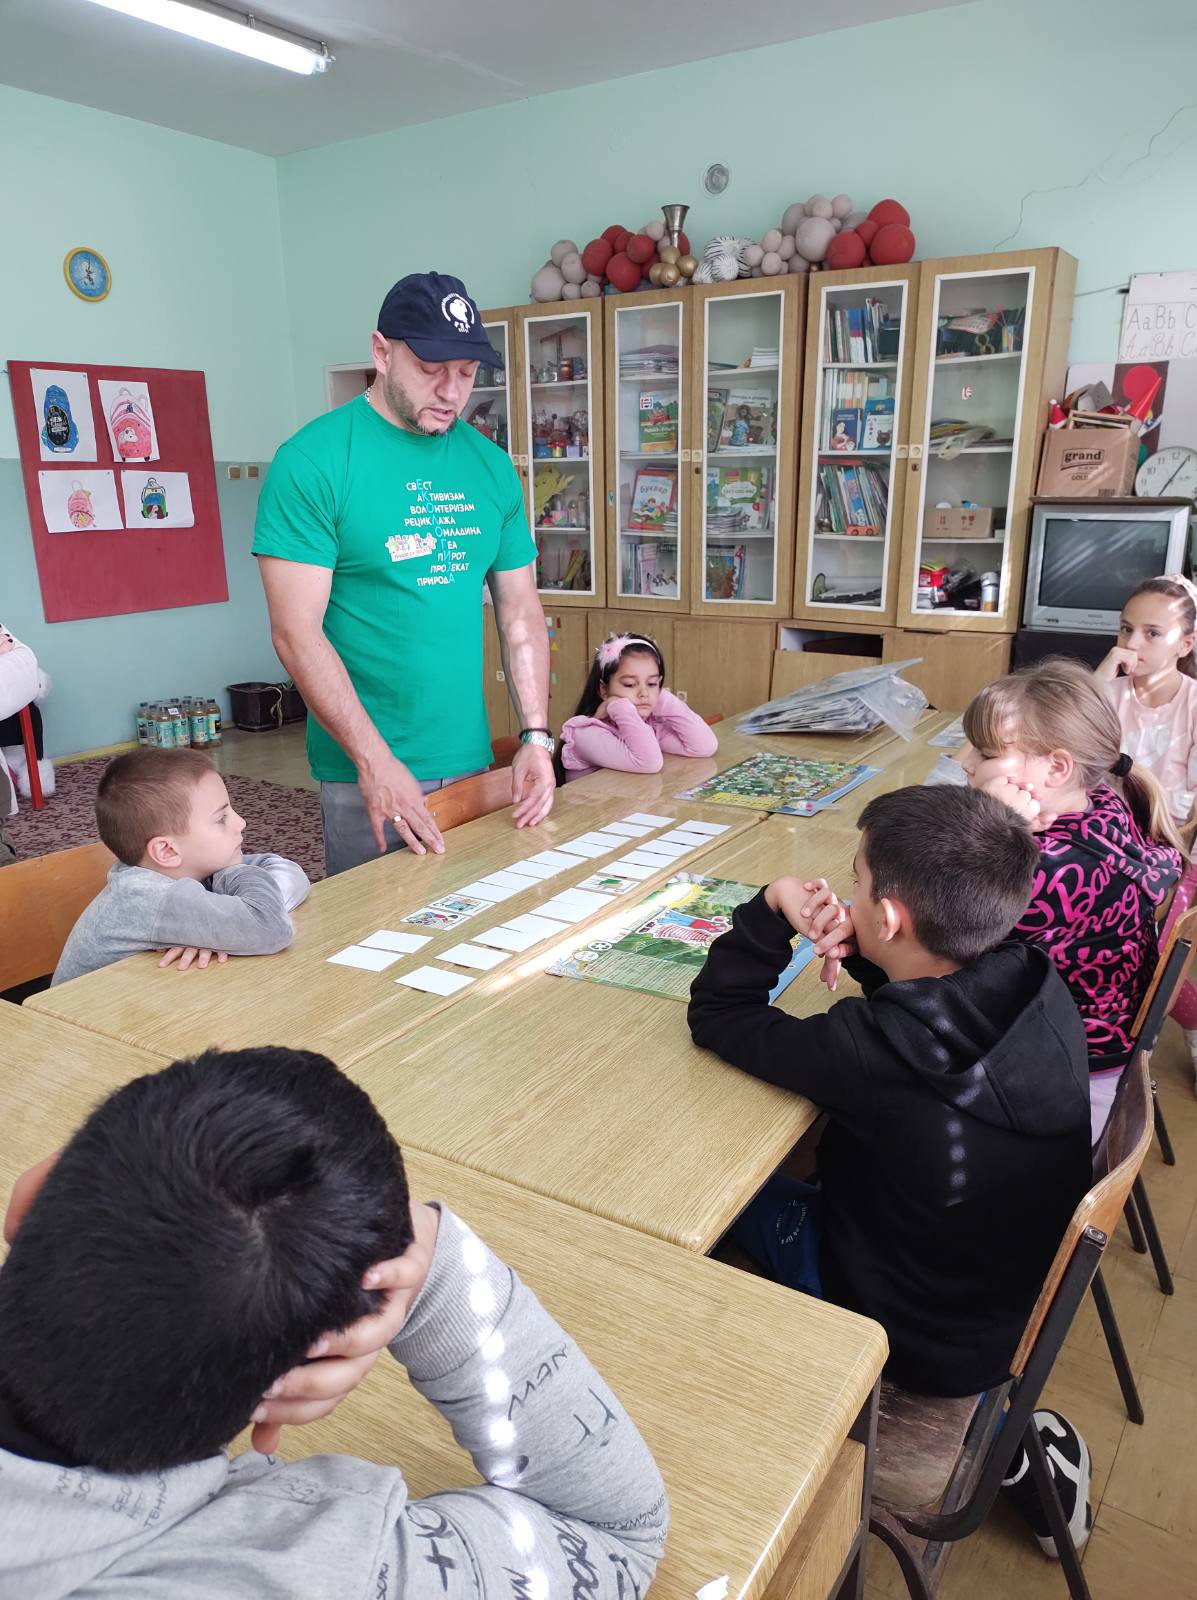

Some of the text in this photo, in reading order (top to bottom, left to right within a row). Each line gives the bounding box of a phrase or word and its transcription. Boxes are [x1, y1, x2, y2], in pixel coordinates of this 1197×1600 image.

[1064, 451, 1102, 463] grand
[406, 479, 432, 491] СВЕСТ
[417, 491, 466, 502] АКТИВИЗАМ
[409, 503, 475, 515] ВОЛОНТЕРИЗАМ
[404, 514, 456, 527] РЕЦИКЛАЖА
[434, 526, 481, 538] ОМЛАДИНА
[437, 550, 467, 562] ПИРОТ
[416, 573, 456, 587] ПРИРОДА
